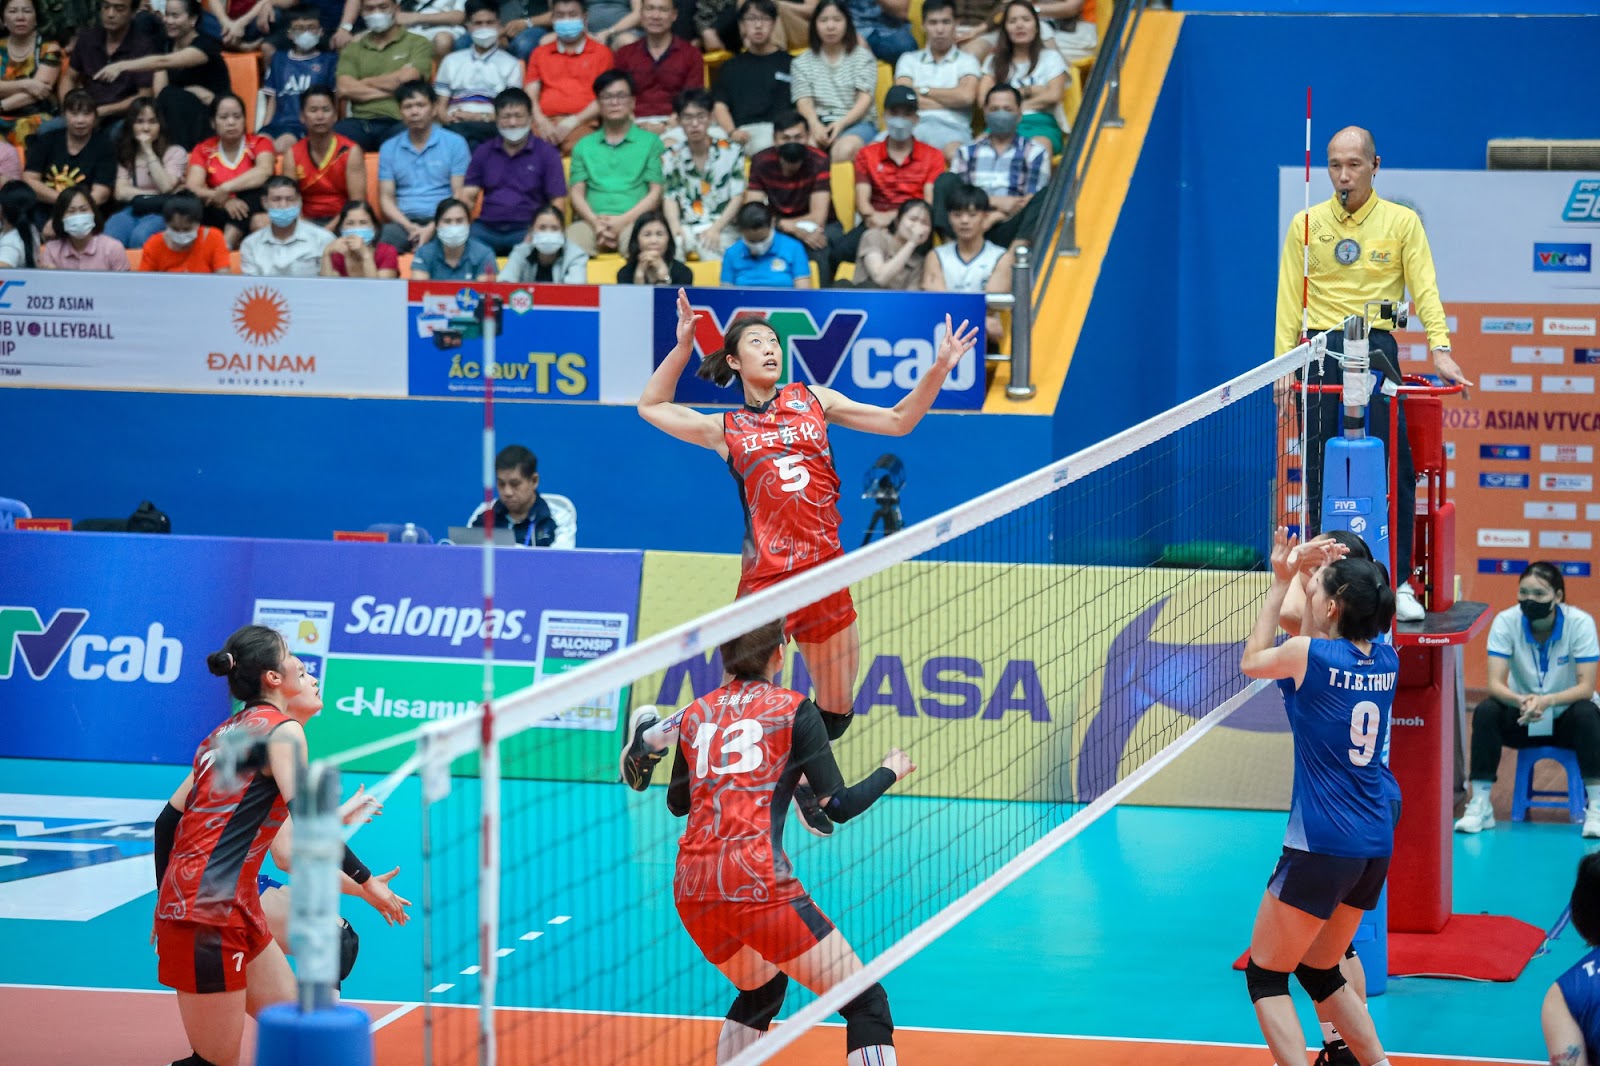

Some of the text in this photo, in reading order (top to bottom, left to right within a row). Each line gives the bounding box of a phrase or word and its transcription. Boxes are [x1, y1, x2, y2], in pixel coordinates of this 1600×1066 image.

[1538, 251, 1588, 267] VTVcab
[26, 295, 94, 311] 2023 ASIAN
[0, 320, 13, 336] B
[257, 354, 316, 374] NAM
[528, 351, 588, 396] TS
[1485, 410, 1538, 430] ASIAN
[741, 421, 819, 454] 辽宁东化
[772, 453, 811, 492] 5
[1334, 500, 1357, 510] FIVB
[344, 595, 526, 646] Salonpas
[551, 636, 613, 652] SALONSIP
[1328, 667, 1397, 692] T.T.B.THUY
[1348, 700, 1380, 767] 9
[691, 718, 764, 779] 13
[232, 951, 244, 972] 7
